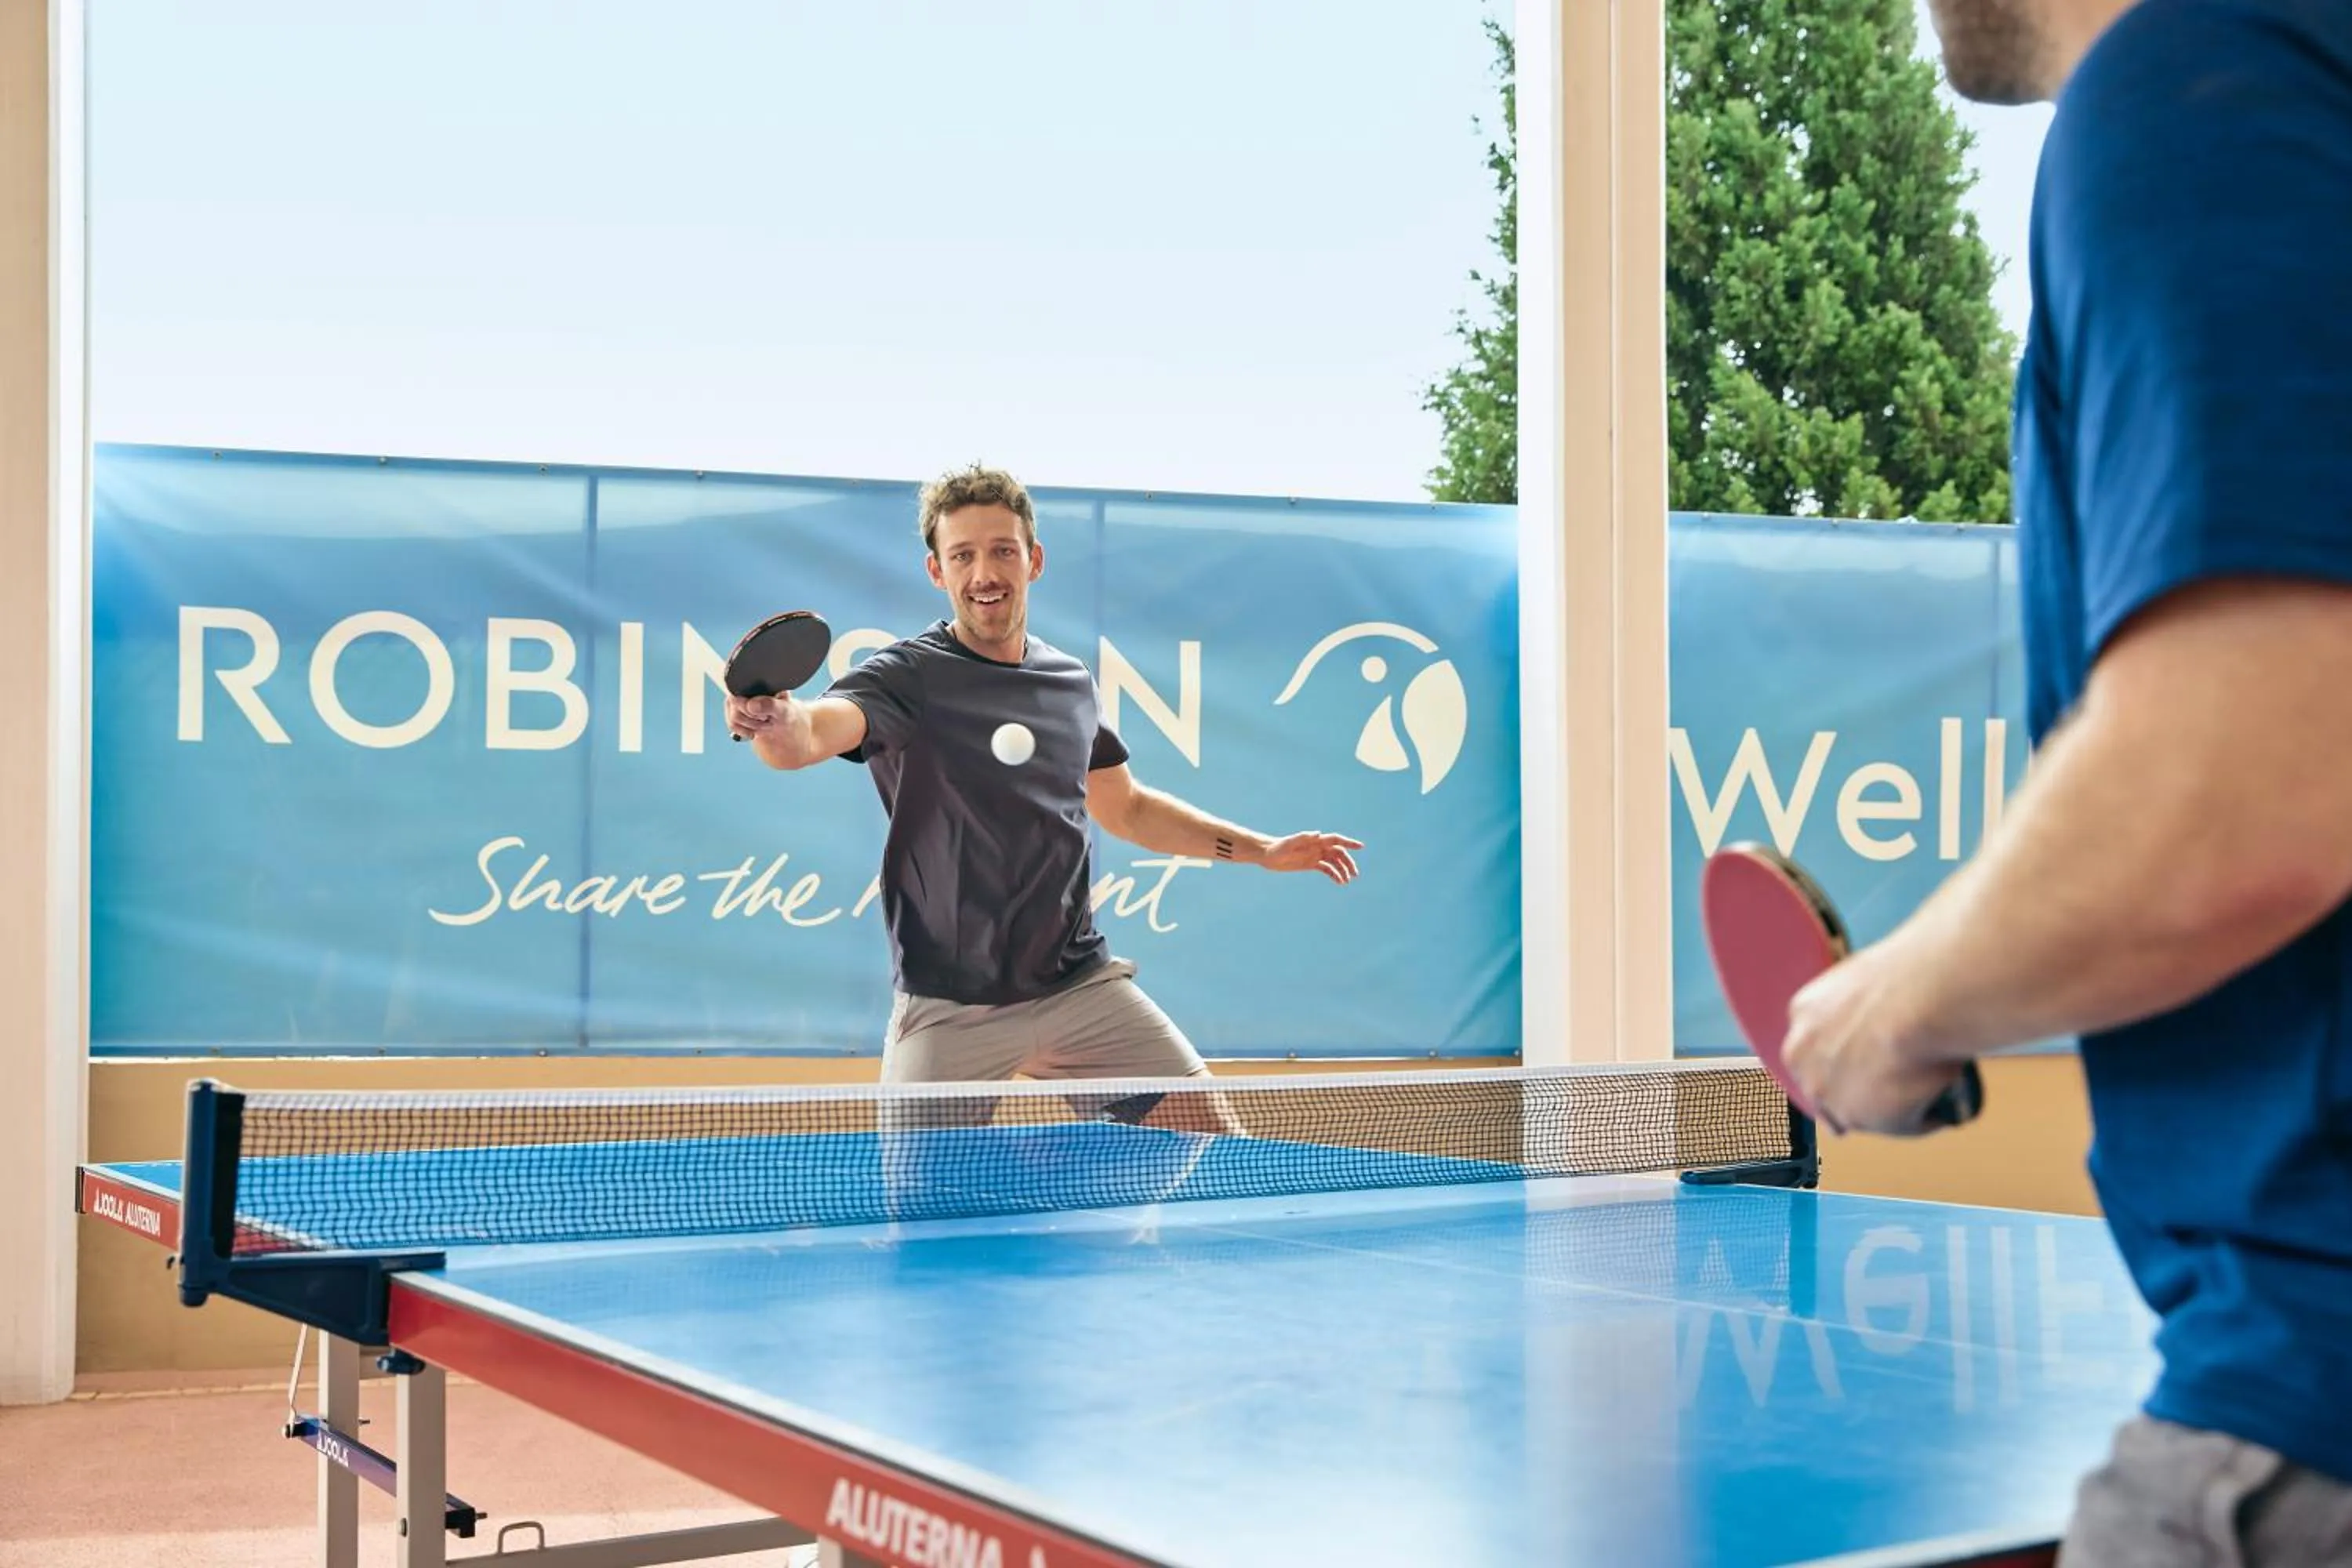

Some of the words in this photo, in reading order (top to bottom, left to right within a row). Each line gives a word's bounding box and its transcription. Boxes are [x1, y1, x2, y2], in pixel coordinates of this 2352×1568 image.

[177, 605, 1202, 768] ROBINN
[1670, 717, 2032, 861] Well
[429, 837, 686, 926] Share
[697, 853, 842, 927] the
[321, 1433, 349, 1468] JOOLA
[826, 1477, 1003, 1568] ALUTERNA
